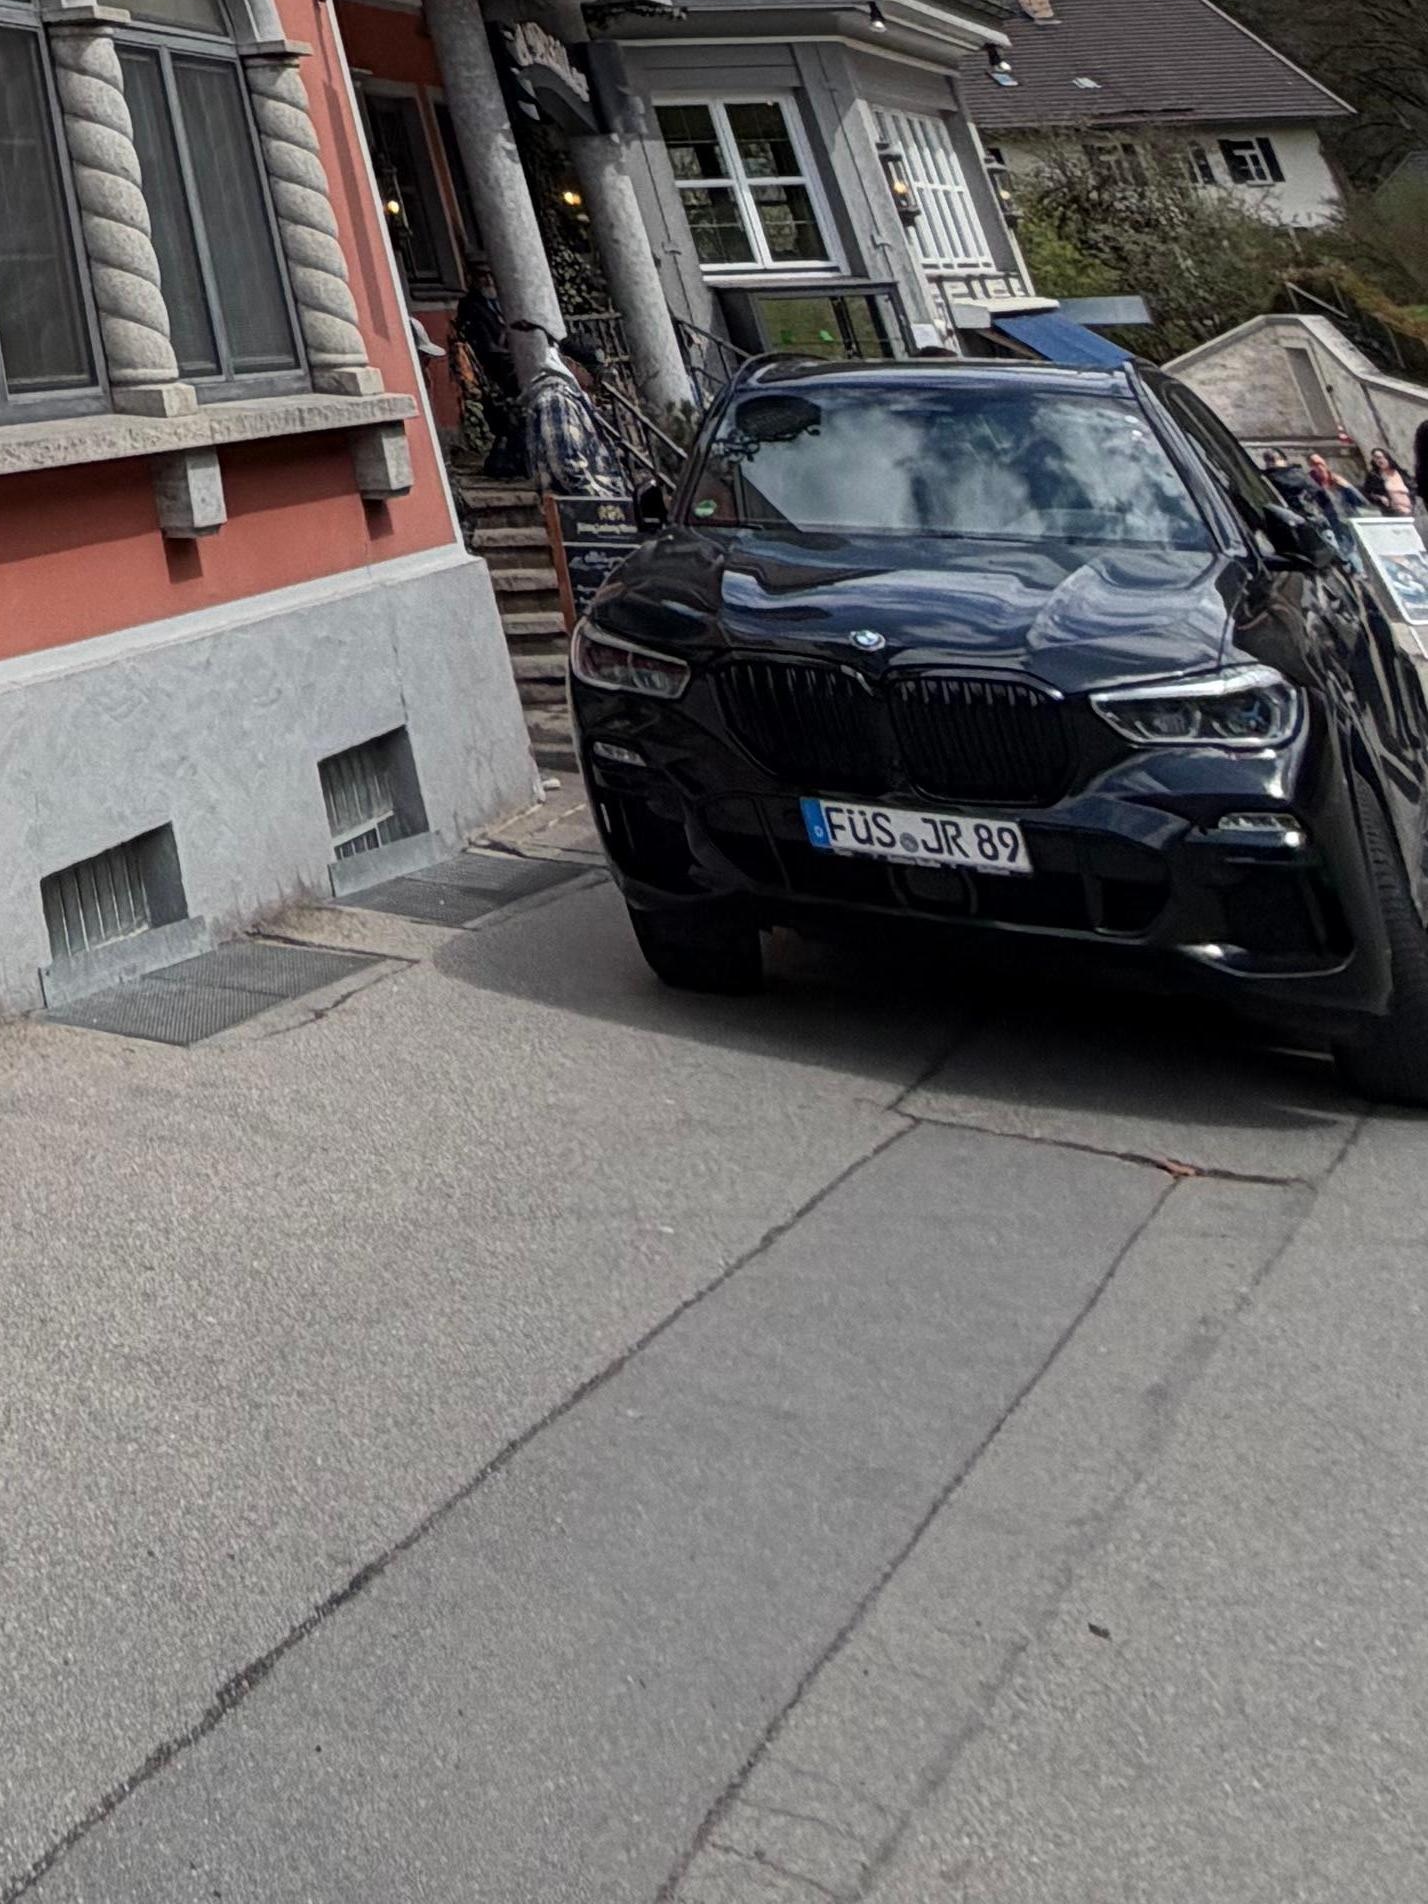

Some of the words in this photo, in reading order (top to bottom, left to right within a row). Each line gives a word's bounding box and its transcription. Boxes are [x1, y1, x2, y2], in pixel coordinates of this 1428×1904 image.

[824, 806, 895, 849] FÜS
[920, 817, 969, 859] JR
[973, 823, 1021, 863] 89
